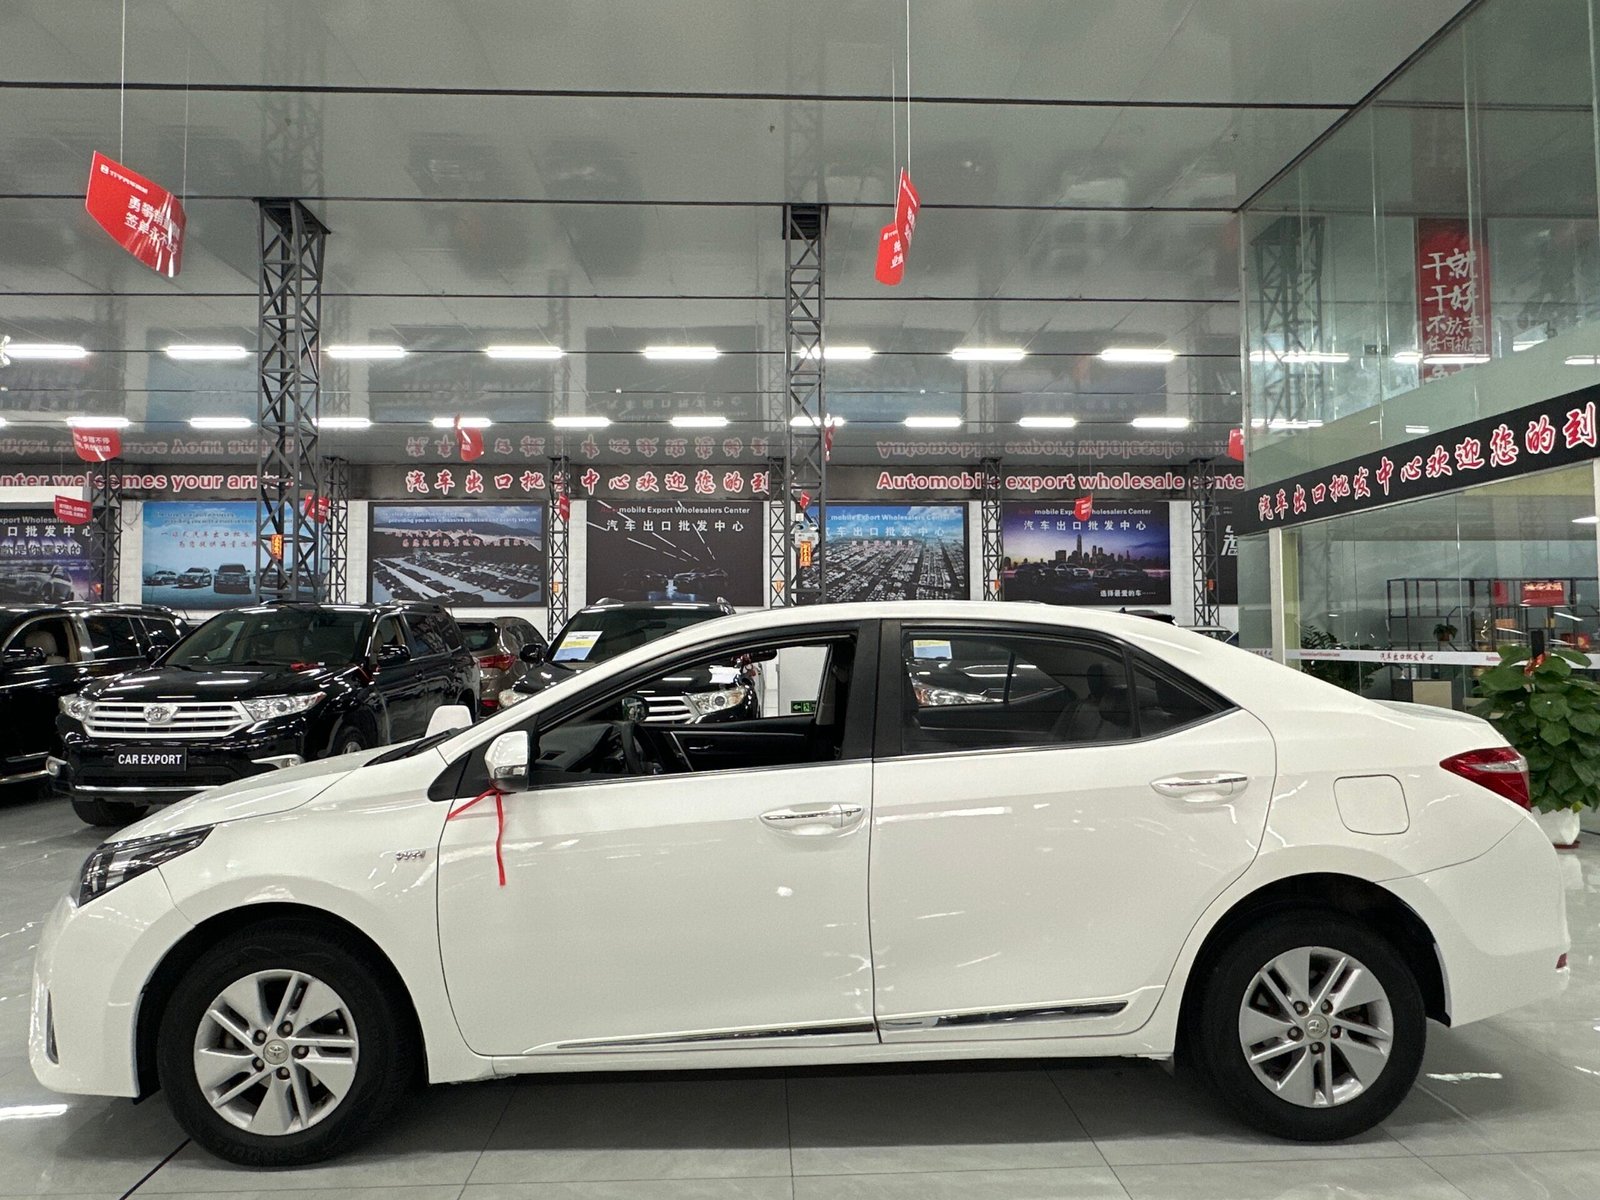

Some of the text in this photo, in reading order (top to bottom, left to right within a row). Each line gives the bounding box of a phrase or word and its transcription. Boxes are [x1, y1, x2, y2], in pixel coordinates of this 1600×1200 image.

[0, 472, 49, 486] nter
[171, 474, 224, 492] your
[1005, 474, 1075, 493] export
[1079, 472, 1185, 490] wholesale
[647, 506, 673, 515] Export
[675, 506, 722, 514] Wholesalers
[723, 506, 750, 514] Center
[606, 519, 745, 533] 汽车出口批发中心
[1024, 520, 1147, 531] 汽车出口批发中心
[118, 754, 182, 765] CAR EXPORT
